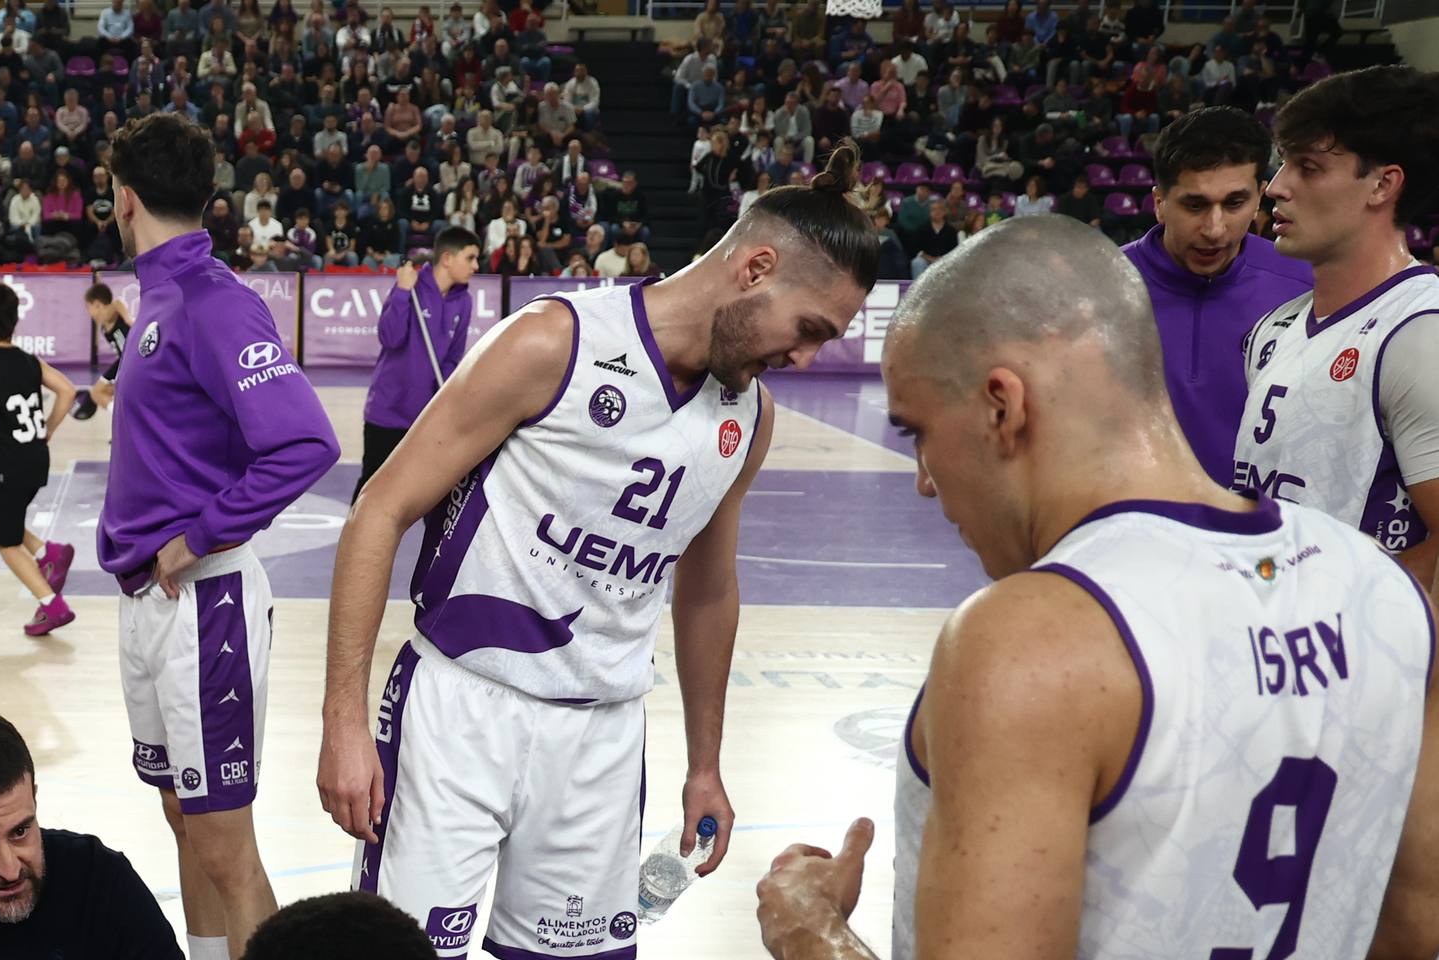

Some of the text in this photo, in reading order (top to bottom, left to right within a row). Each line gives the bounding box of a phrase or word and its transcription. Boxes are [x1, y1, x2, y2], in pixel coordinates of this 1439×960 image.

[238, 363, 299, 391] HYUNDAI
[594, 360, 638, 377] MERCURY
[1254, 384, 1288, 444] 5
[611, 457, 686, 530] 21
[1228, 459, 1306, 504] EMC
[536, 513, 680, 584] UEMC
[221, 760, 248, 780] CBC
[536, 926, 607, 937] DE VALLADOLID
[537, 916, 607, 929] ALIMENTOS
